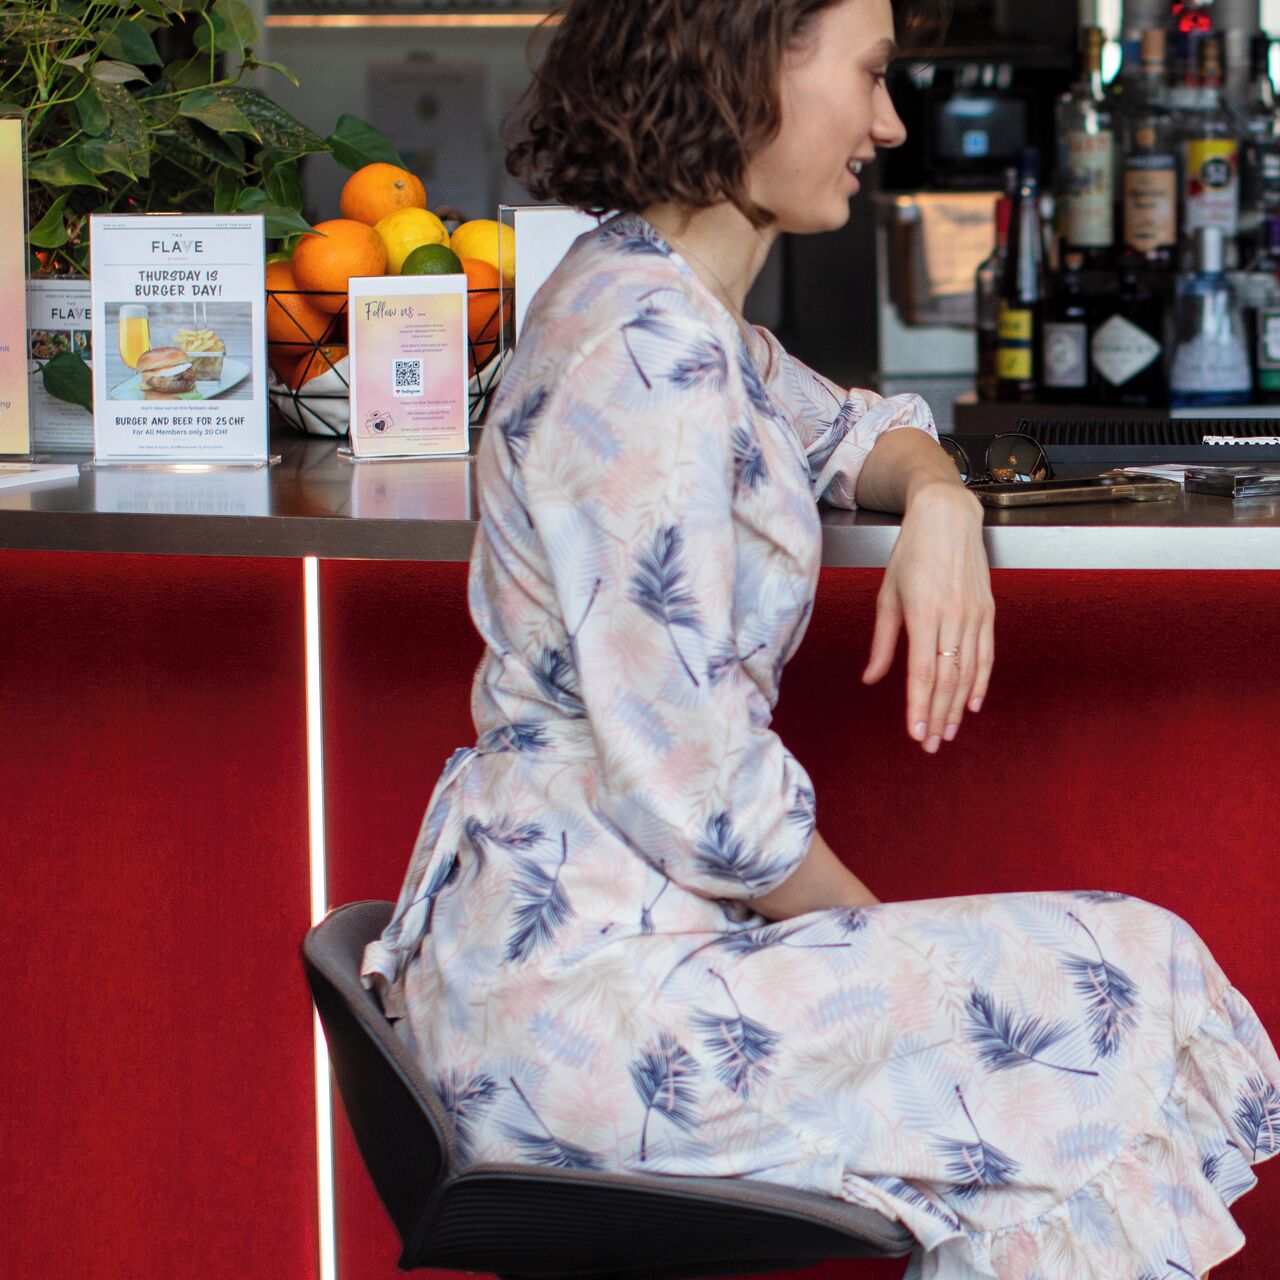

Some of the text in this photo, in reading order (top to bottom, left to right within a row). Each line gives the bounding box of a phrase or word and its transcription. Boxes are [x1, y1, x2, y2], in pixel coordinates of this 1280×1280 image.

[151, 240, 204, 253] FLAVE
[138, 270, 219, 282] THURSDAY IS
[134, 284, 222, 297] BURGER DAY!
[51, 308, 92, 320] FLAVE
[364, 300, 397, 320] Follow
[400, 306, 414, 319] us
[115, 416, 246, 426] BURGER AND BEER FOR 25 CHF
[188, 429, 203, 437] only
